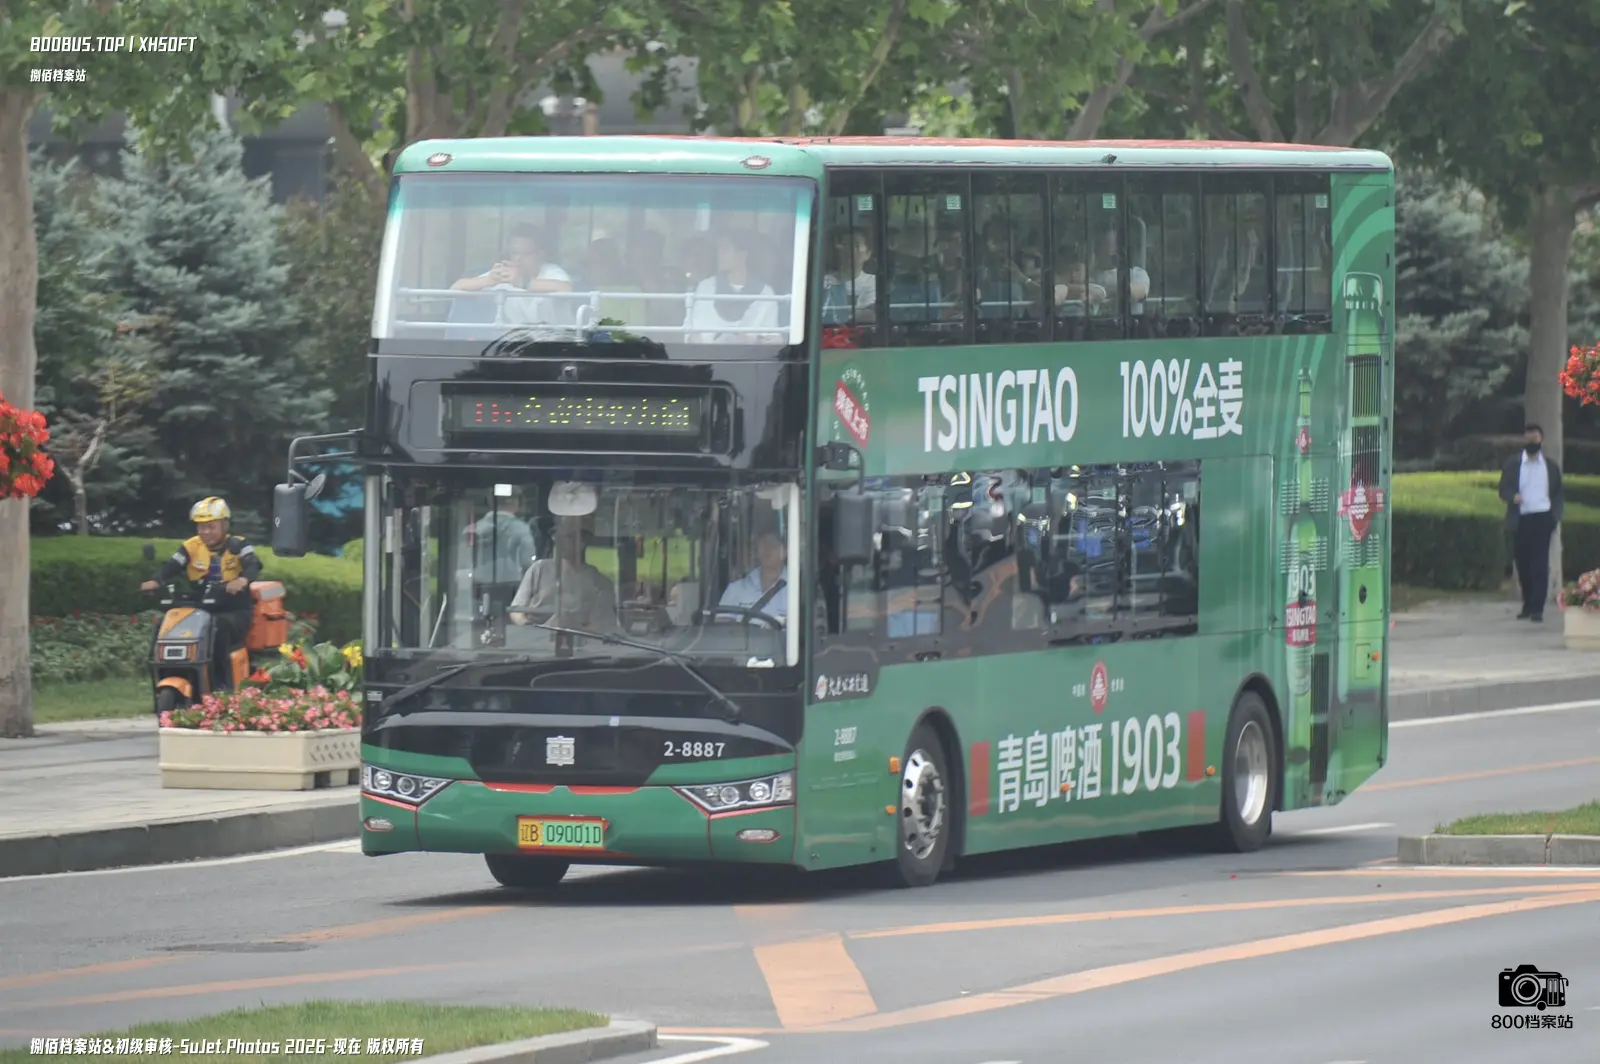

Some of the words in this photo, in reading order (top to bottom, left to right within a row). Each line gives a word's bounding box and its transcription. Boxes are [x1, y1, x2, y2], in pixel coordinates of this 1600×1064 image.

[918, 366, 1079, 453] TSINGTAO
[663, 740, 726, 758] 2-8887
[997, 722, 1103, 814] 青岛啤酒
[1110, 711, 1181, 796] 1903
